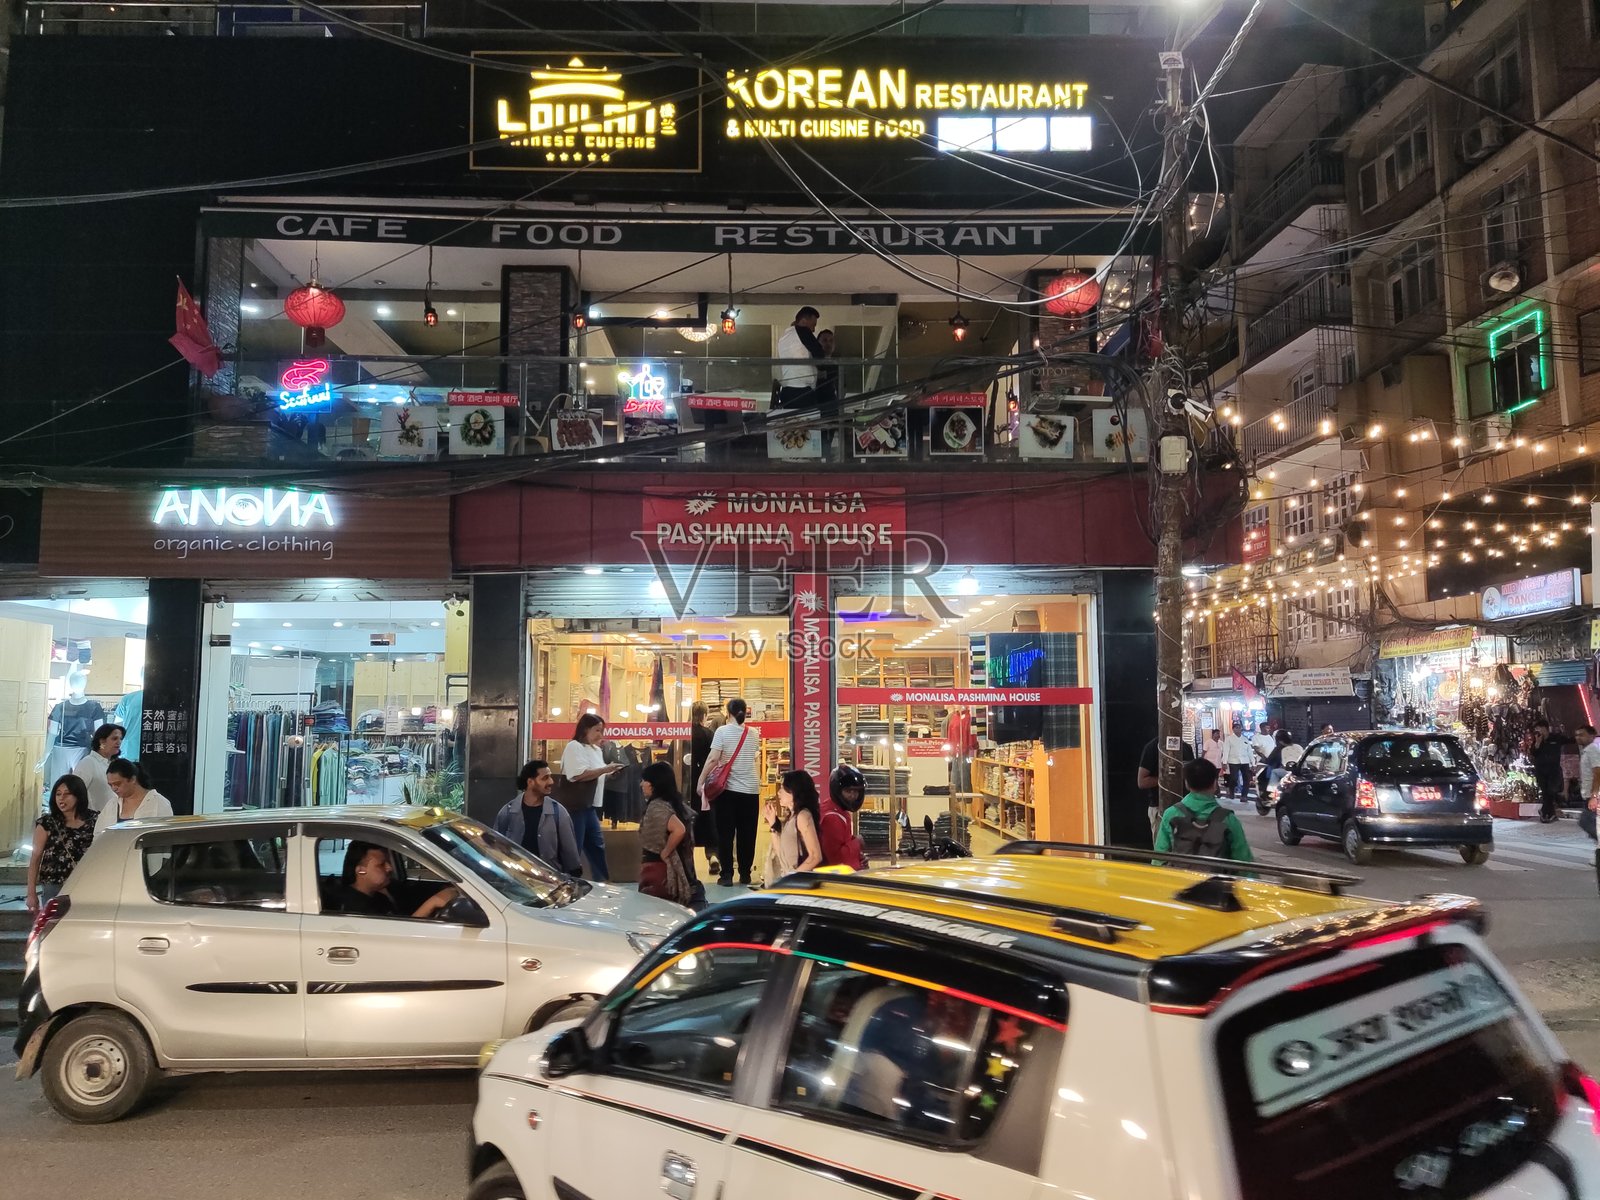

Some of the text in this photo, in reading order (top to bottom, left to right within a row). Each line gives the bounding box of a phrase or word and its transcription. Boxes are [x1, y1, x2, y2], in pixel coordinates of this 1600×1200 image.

[727, 69, 1088, 109] KOREAN RESTAURANT
[727, 119, 925, 138] & MULTI CUISINE FOOD
[500, 134, 656, 148] NESE CUISINE
[276, 215, 1053, 246] CAFE FOOD RESTAURANT
[727, 492, 867, 513] MONALISA
[657, 523, 893, 545] PASHMINA HOUSE
[1520, 577, 1546, 592] NIGHT
[1507, 592, 1541, 606] DANCE
[1545, 585, 1568, 599] BAR
[803, 617, 821, 697] MONALISA
[906, 693, 1041, 702] MONALISA PASHMINA HOUSE
[603, 726, 691, 737] MONALISA PASHMI
[803, 702, 821, 777] PASHMINA
